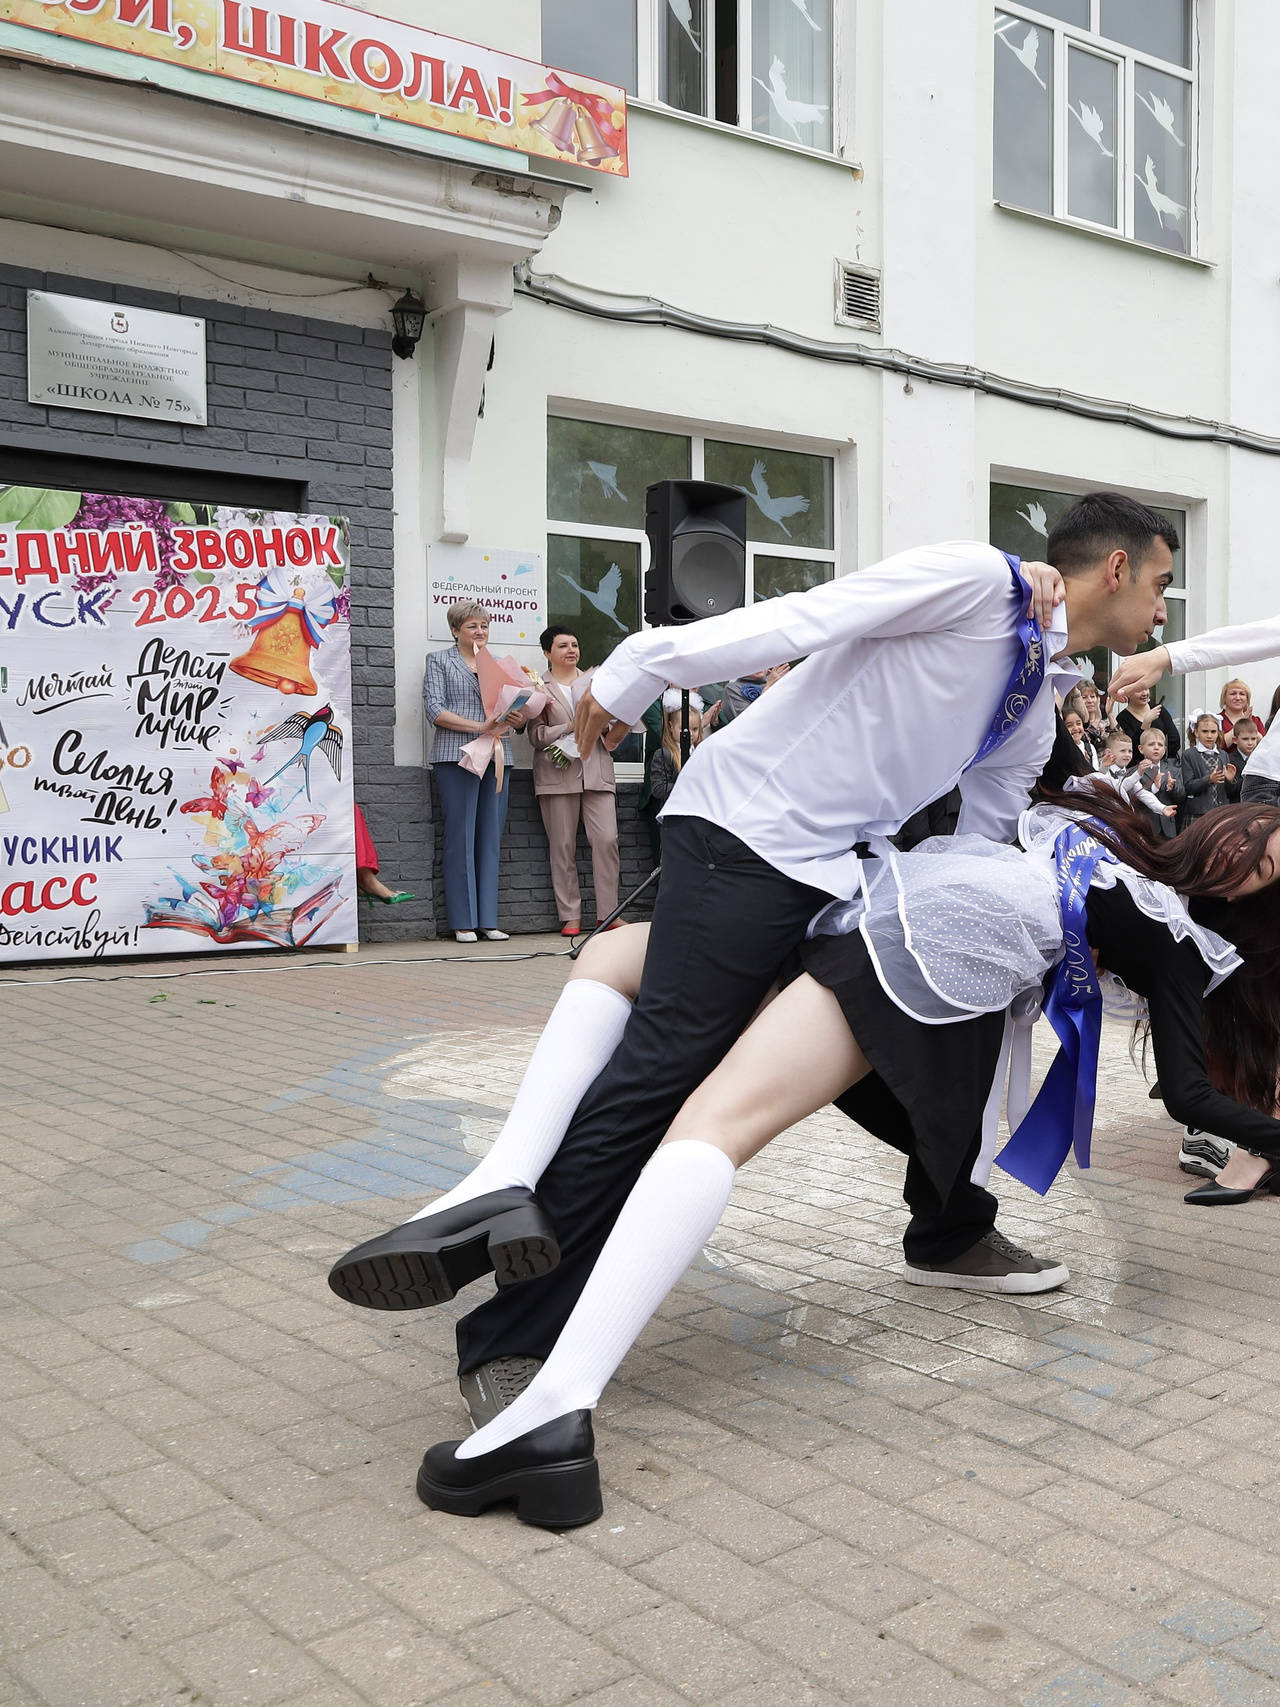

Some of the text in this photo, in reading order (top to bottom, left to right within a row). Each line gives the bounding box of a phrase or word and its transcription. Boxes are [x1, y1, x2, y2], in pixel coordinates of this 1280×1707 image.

[223, 0, 512, 123] ШКОЛА!
[80, 340, 126, 351] Департамент
[130, 340, 161, 350] Нижнего
[162, 345, 198, 356] Новгорода
[64, 360, 175, 382] ОБЩЕОБРАЗОВАТЕЛЬНОЕ
[89, 372, 151, 386] УЧРЕЖДЕНИЕ
[132, 362, 190, 377] БЮДЖЕТНОЕ
[46, 383, 191, 413] «ШКОЛА № 75»
[172, 527, 342, 571] ЗВОНОК
[431, 581, 538, 597] ФЕДЕРАЛЬНЫЙ ПРОЕКТ
[476, 598, 538, 611] КАЖДОГО
[131, 582, 261, 628] 2025
[126, 637, 230, 688] Делай
[16, 663, 118, 707] Мечтай
[137, 679, 219, 725] Мир
[52, 729, 174, 796] Сегодня
[34, 777, 99, 804] твой
[80, 791, 178, 834] День!
[3, 834, 124, 867] УСКНИК
